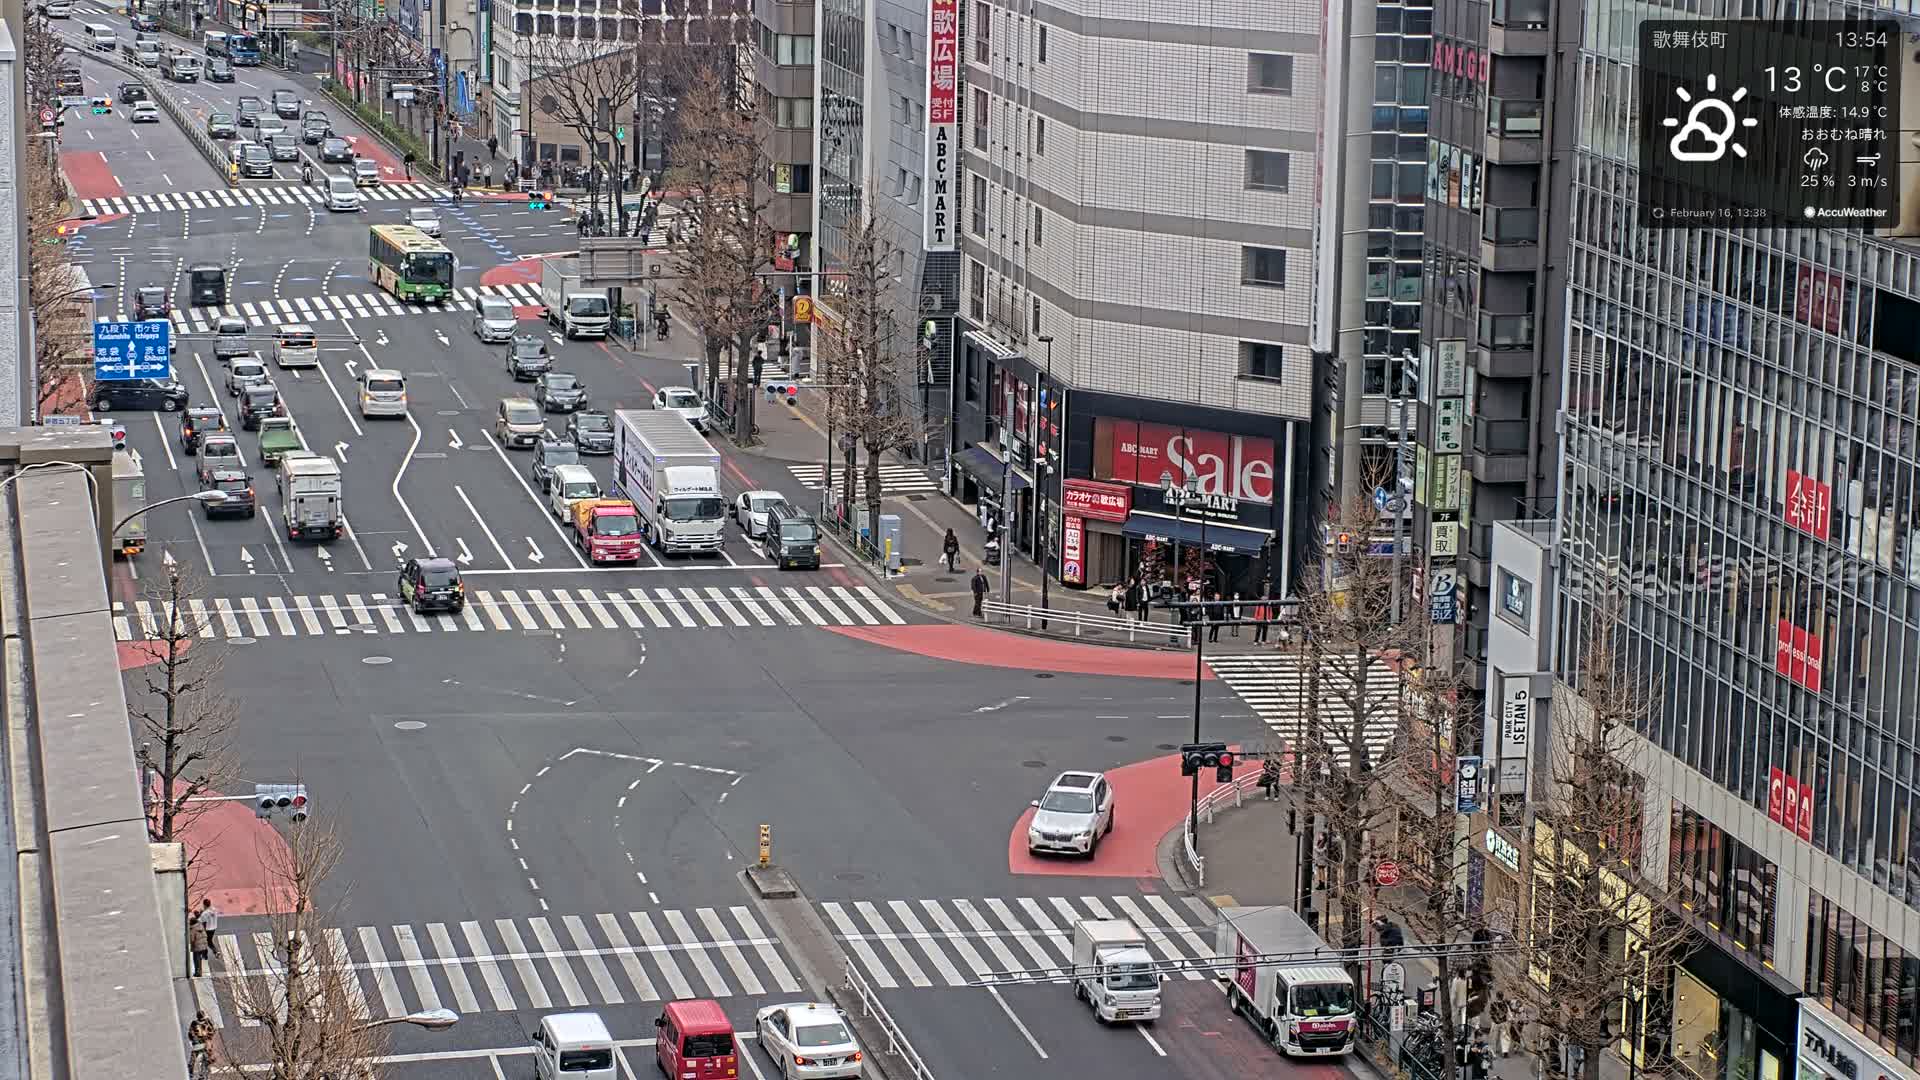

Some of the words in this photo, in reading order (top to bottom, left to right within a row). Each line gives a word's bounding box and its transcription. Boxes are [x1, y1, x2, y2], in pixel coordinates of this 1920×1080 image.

[933, 10, 955, 90] 歌広場
[1434, 42, 1487, 80] AMIGO
[932, 97, 953, 108] 受付
[932, 109, 953, 119] 5F
[101, 324, 128, 333] 九段下
[97, 346, 119, 356] 池袋
[1167, 436, 1273, 503] Sale
[1790, 480, 1826, 530] 会計
[1440, 513, 1451, 521] 7F
[1435, 525, 1449, 553] 買取
[1778, 640, 1822, 672] professional
[1515, 690, 1527, 700] 5
[1505, 701, 1513, 718] CITY
[1505, 720, 1513, 738] PARK
[1513, 704, 1527, 744] ISETAN
[1772, 778, 1810, 828] CPA
